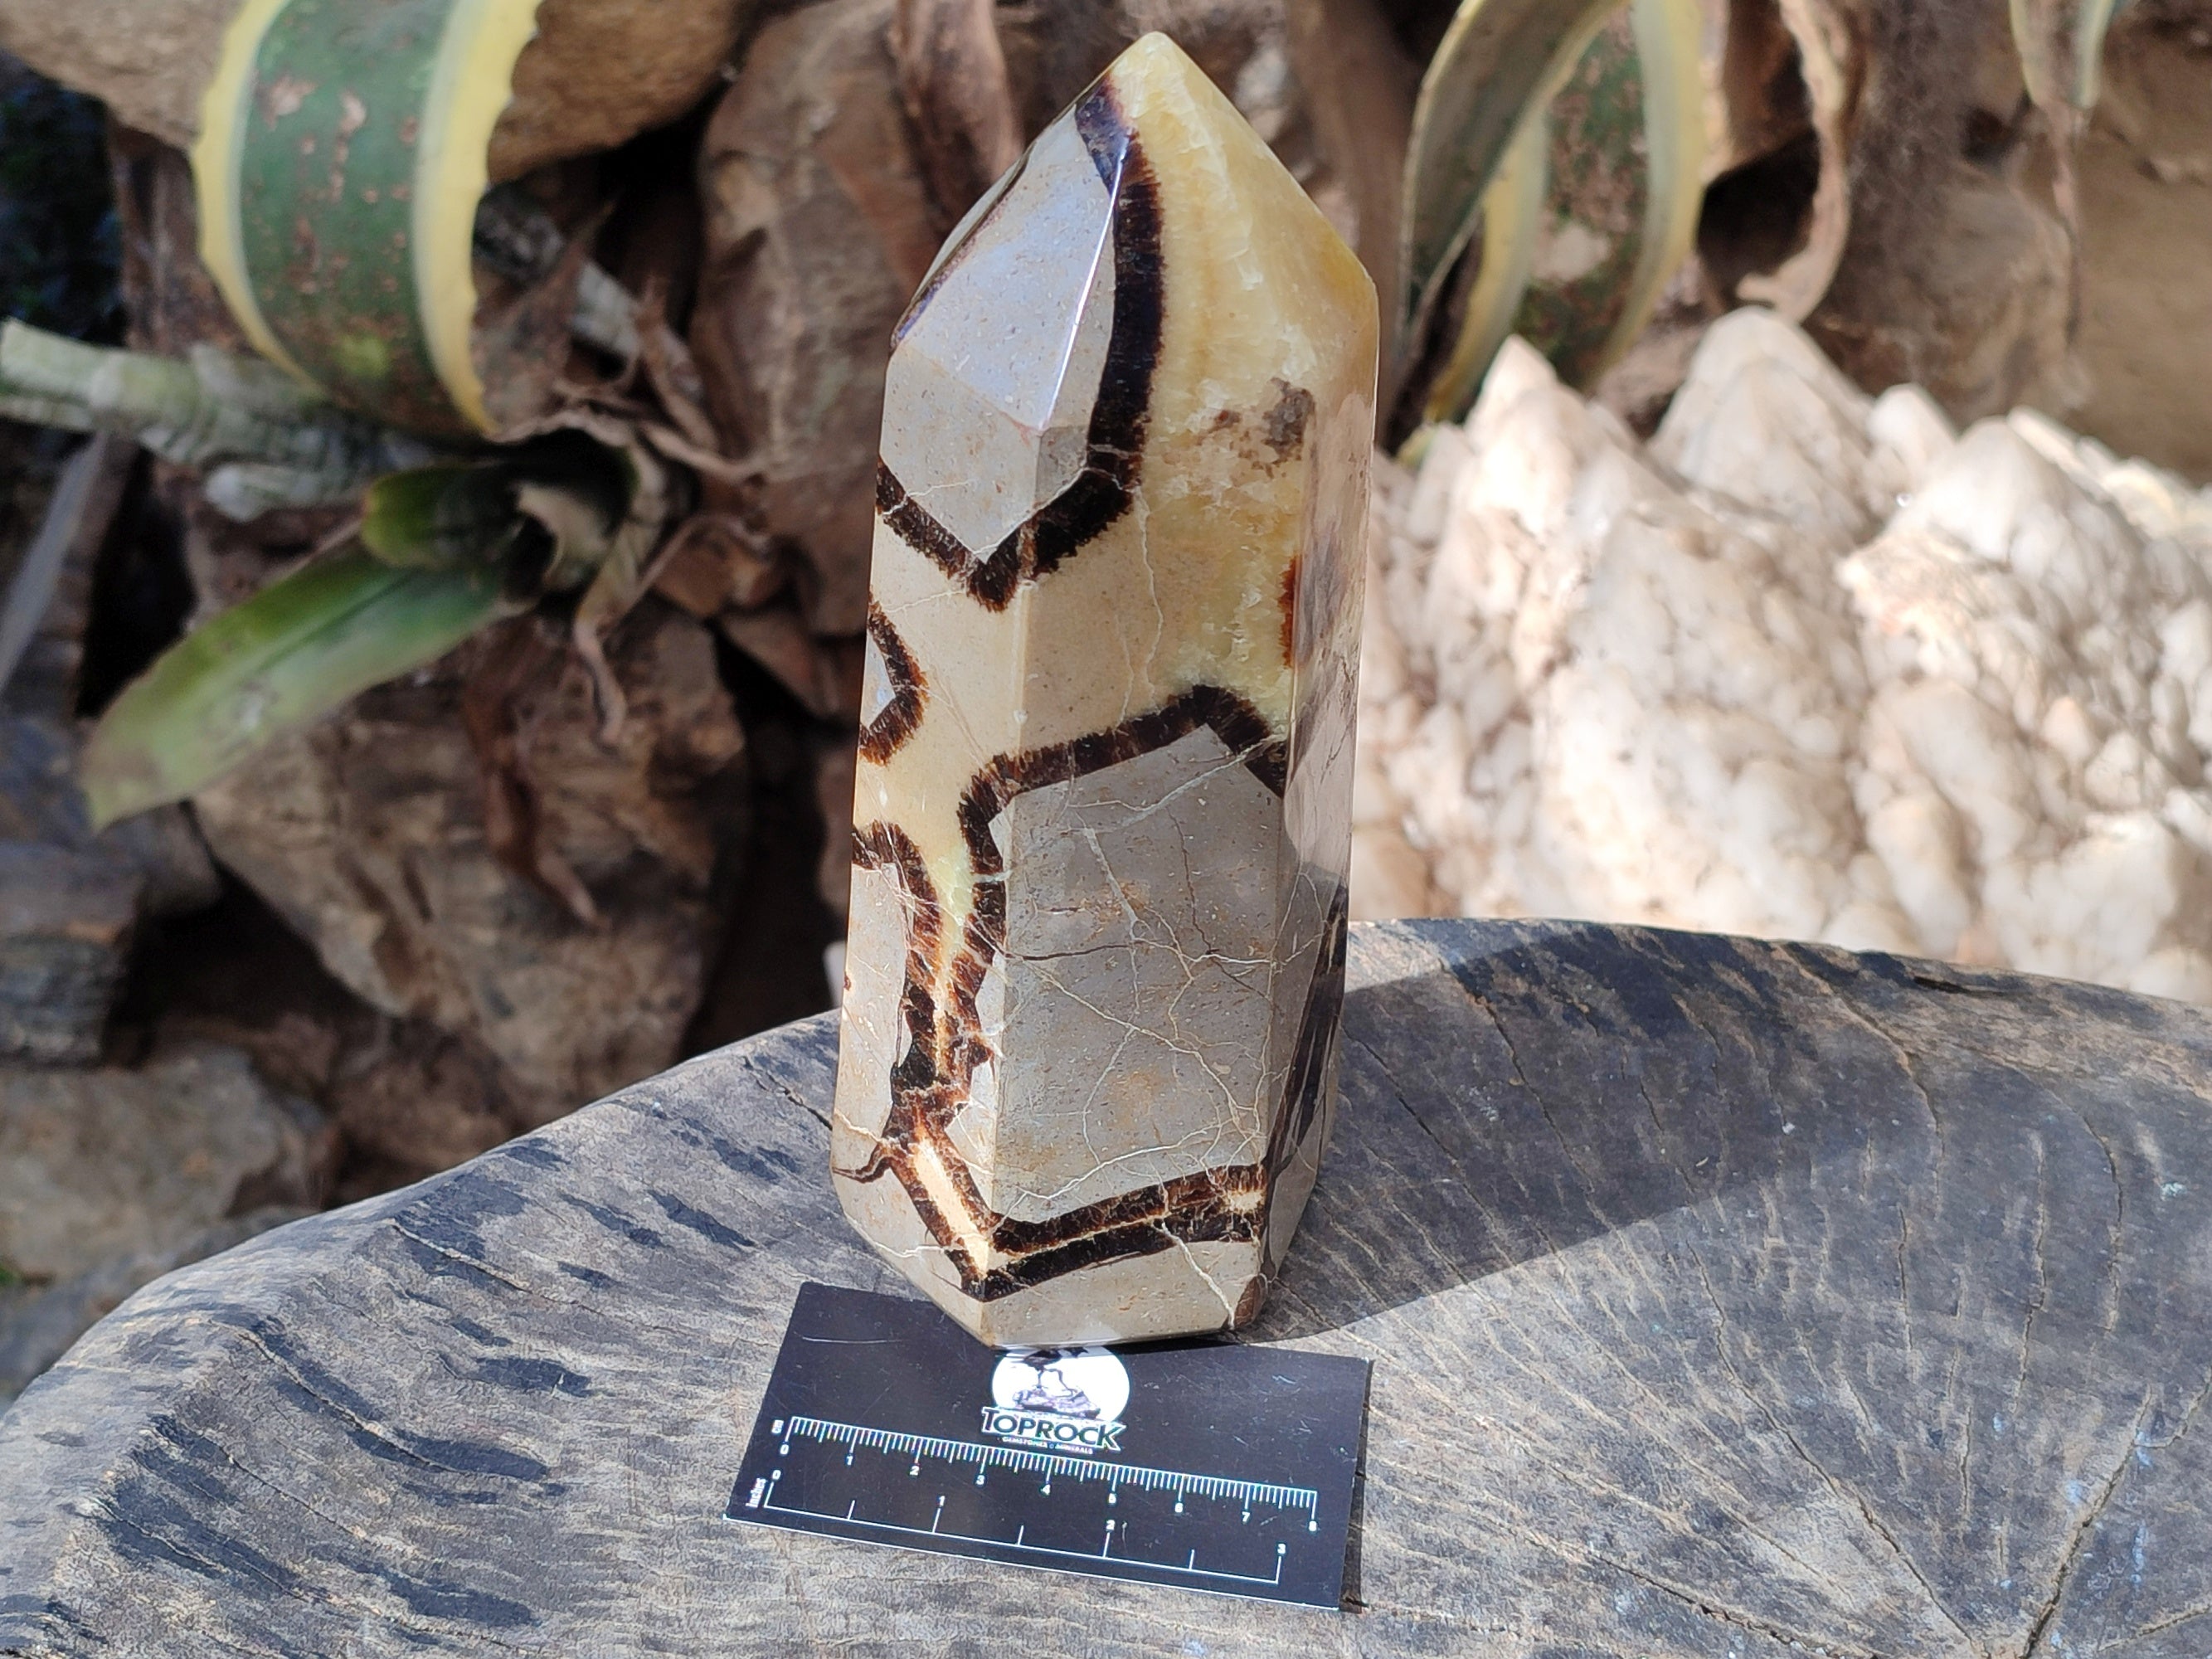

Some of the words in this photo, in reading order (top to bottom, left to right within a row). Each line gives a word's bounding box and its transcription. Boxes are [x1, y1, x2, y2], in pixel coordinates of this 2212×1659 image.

[982, 1406, 1126, 1452] TOPROCK
[746, 1477, 766, 1508] Inches
[772, 1469, 780, 1480] 0
[938, 1496, 945, 1506] 1
[1106, 1520, 1115, 1531] 2
[1277, 1544, 1286, 1554] 3
[780, 1444, 789, 1456] 0
[846, 1455, 853, 1466] 1
[909, 1466, 919, 1477] 2
[976, 1475, 984, 1485] 3
[1042, 1484, 1051, 1496] 4
[1108, 1493, 1116, 1504] 5
[1174, 1502, 1184, 1513] 6
[1242, 1511, 1251, 1522] 7
[1309, 1520, 1317, 1532] 8
